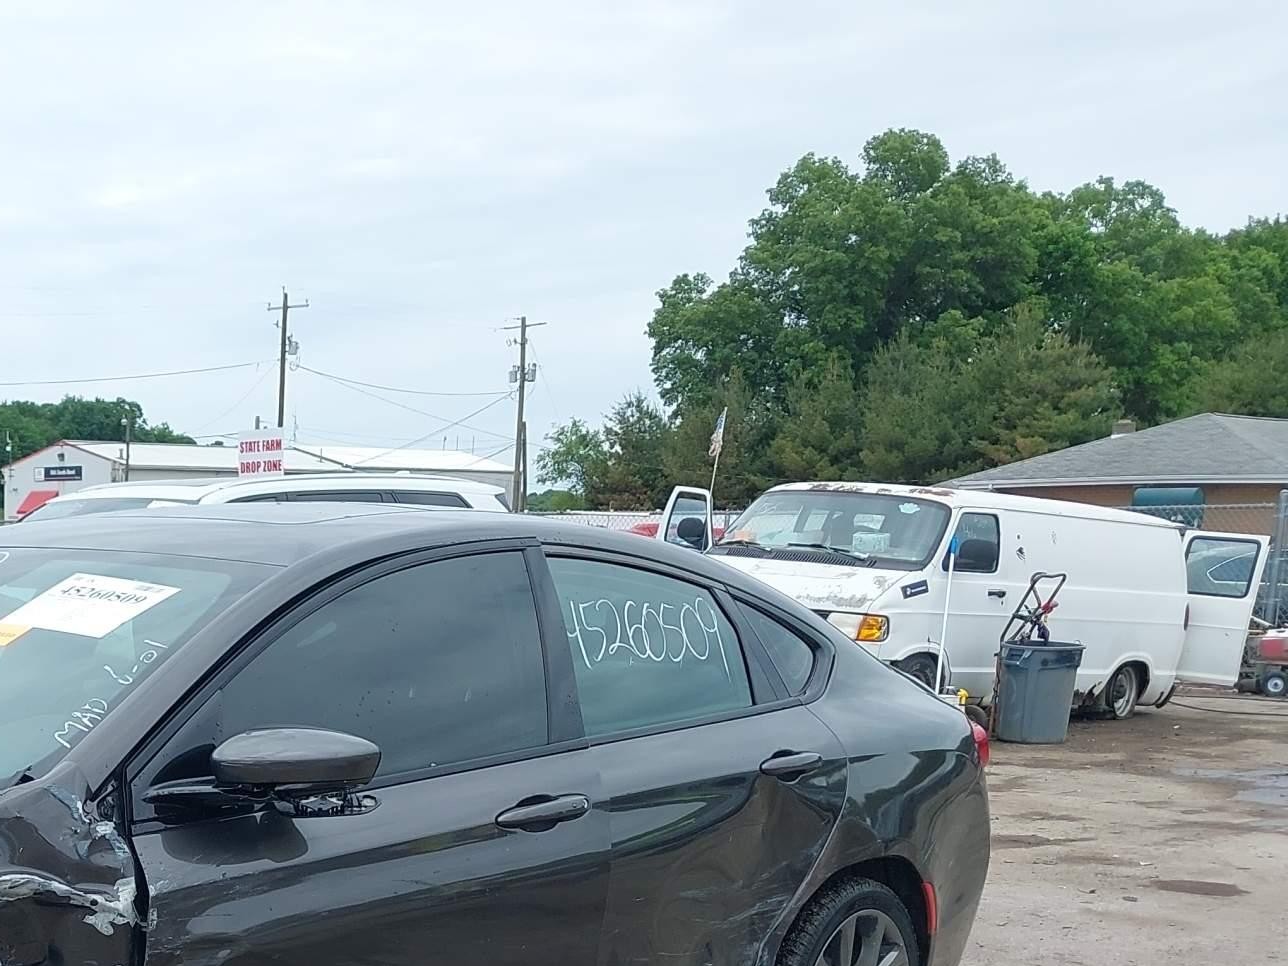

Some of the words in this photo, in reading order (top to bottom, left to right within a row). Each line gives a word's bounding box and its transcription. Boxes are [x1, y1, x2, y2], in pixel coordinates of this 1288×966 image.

[240, 441, 261, 454] STATE
[263, 439, 282, 452] FARM
[241, 461, 261, 473] DROP
[263, 460, 282, 472] ZONE
[61, 585, 148, 605] 45260509
[567, 597, 732, 682] 45260509
[54, 698, 108, 748] MAD
